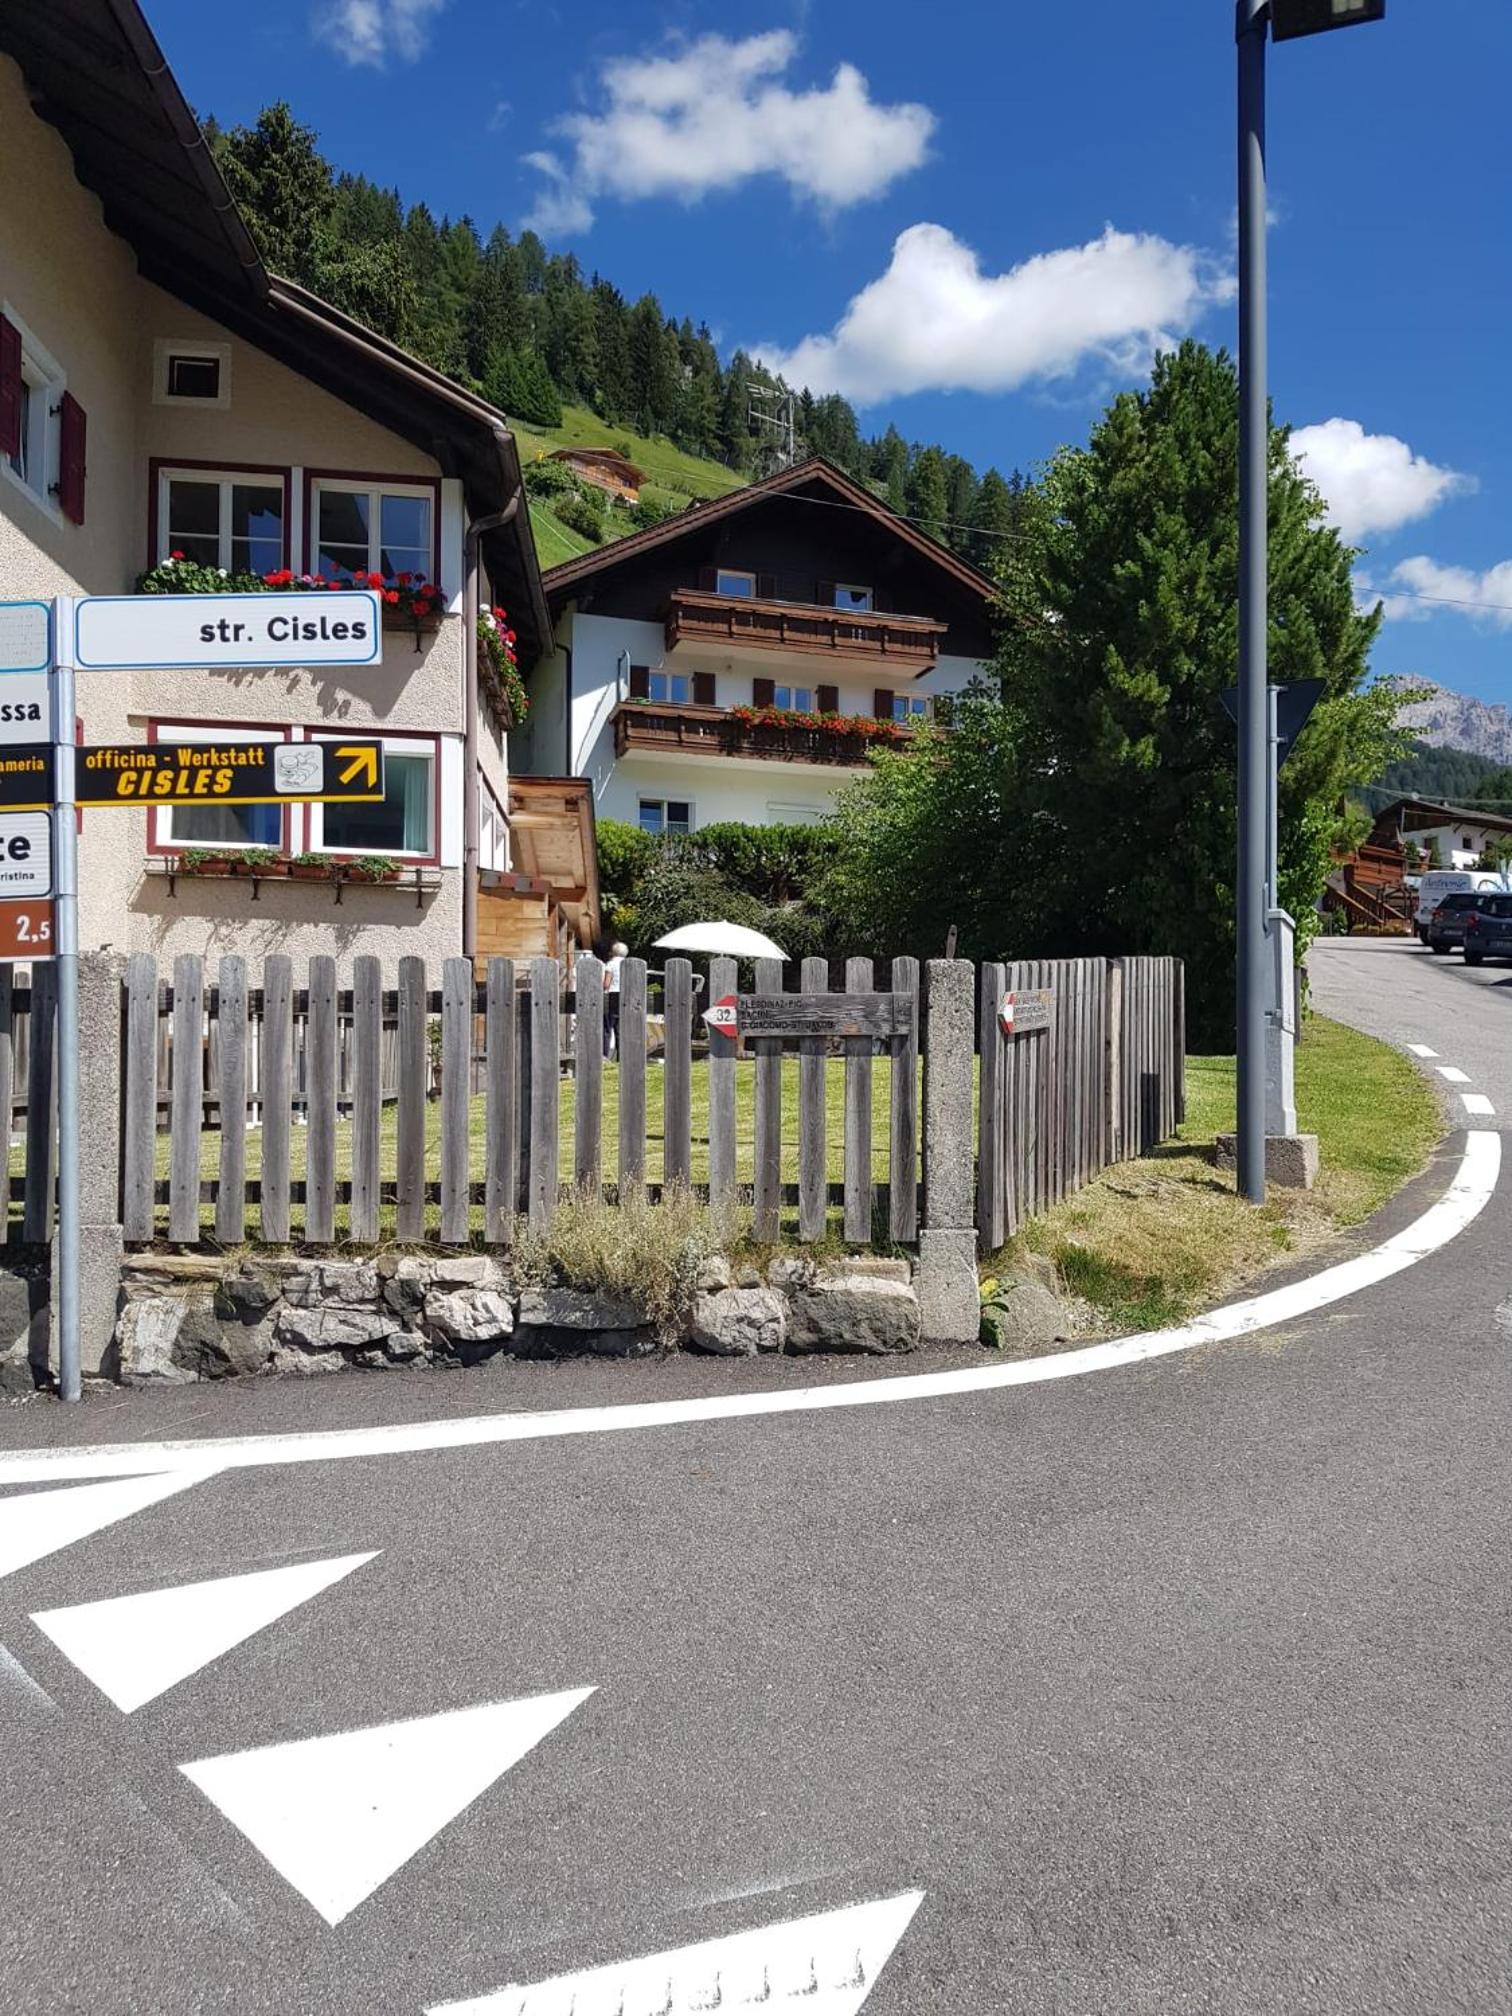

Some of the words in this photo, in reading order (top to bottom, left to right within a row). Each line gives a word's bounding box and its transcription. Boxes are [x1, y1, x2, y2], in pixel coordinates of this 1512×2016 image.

[199, 618, 253, 643] str.
[267, 616, 367, 642] Cisles
[0, 703, 41, 722] ssa
[86, 750, 156, 769] officina
[177, 747, 265, 767] Werkstatt
[116, 769, 234, 796] CISLES
[16, 915, 50, 943] 2,5
[716, 1008, 731, 1022] 32
